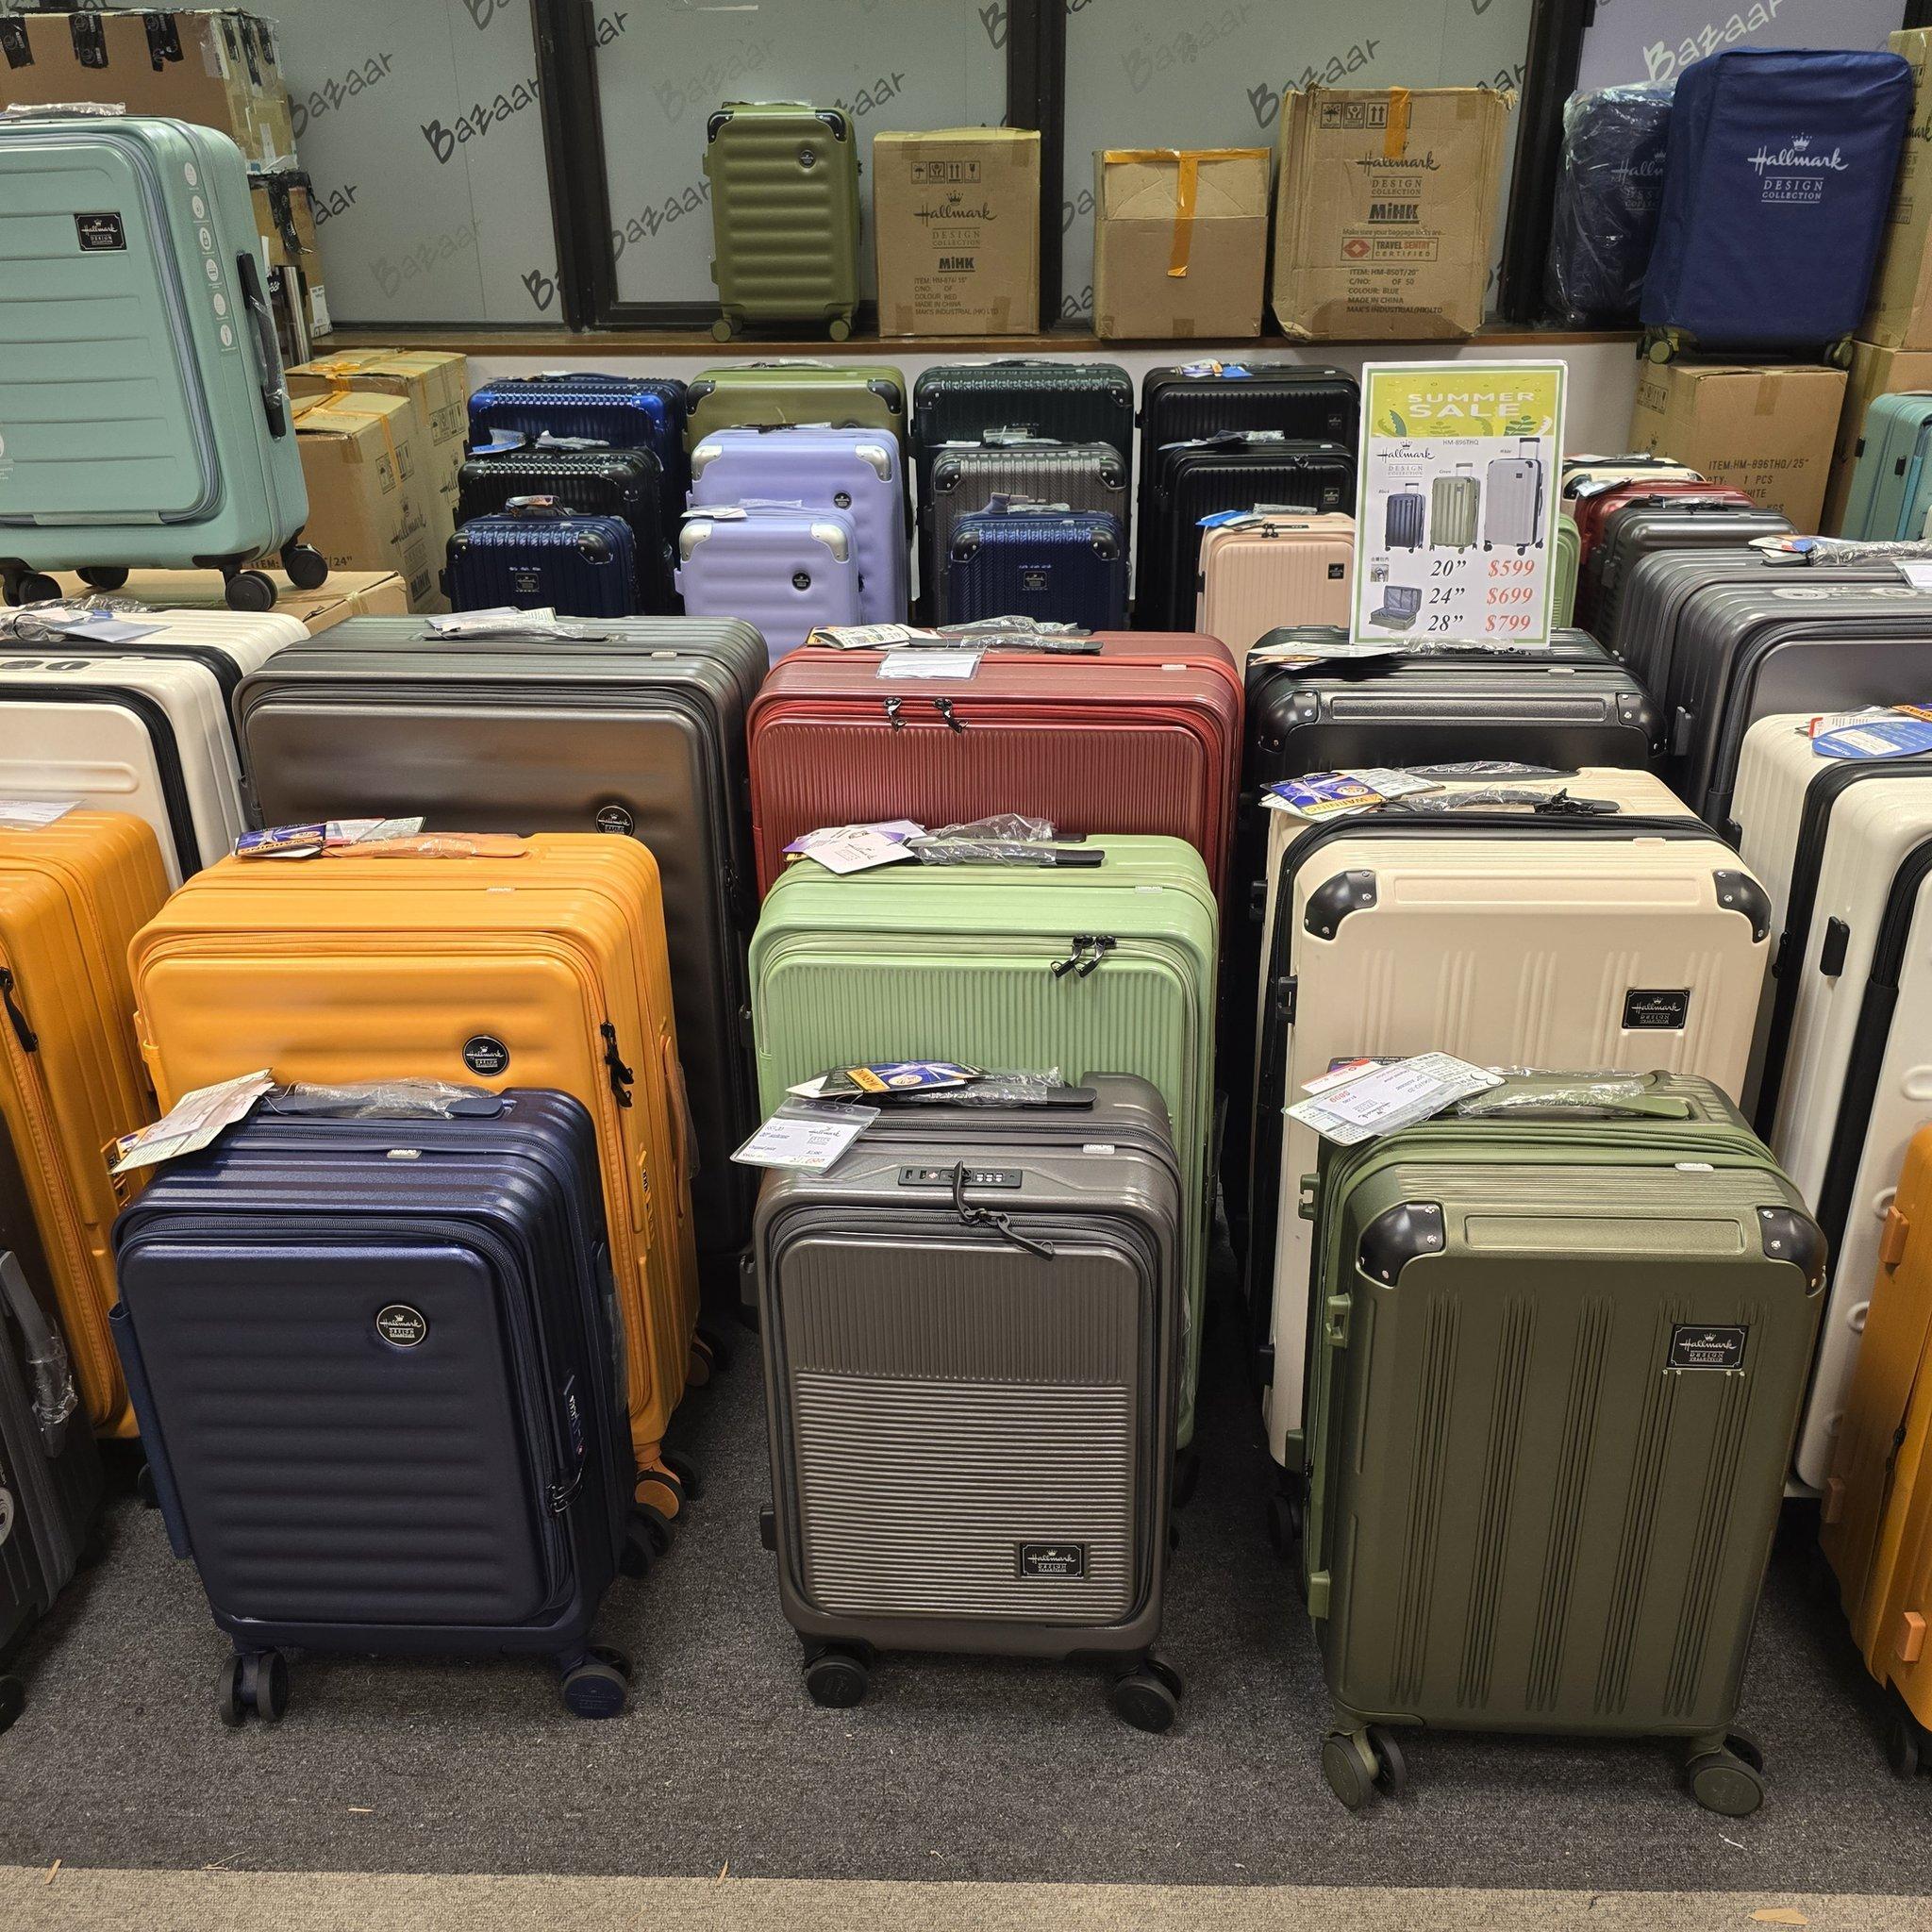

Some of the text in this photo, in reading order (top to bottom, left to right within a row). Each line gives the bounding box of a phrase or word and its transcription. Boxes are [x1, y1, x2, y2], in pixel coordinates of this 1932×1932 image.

[421, 77, 541, 164] Bazaar
[1747, 147, 1849, 176] Hallmark
[1371, 178, 1422, 188] DESIGN
[1763, 180, 1824, 192] DESIGN
[1762, 192, 1822, 200] COLLECTION
[913, 202, 998, 227] Hallmark
[933, 229, 981, 239] DESIGN
[1376, 241, 1403, 250] TRAVEL
[939, 257, 975, 270] MiHK
[1407, 391, 1535, 404] SUMMER
[1408, 403, 1520, 419] SALE
[1376, 446, 1436, 463] Hallmark
[1756, 475, 1774, 485] PCS
[1488, 558, 1536, 577] $599
[1486, 587, 1534, 605] $699
[1485, 614, 1531, 633] $799
[1631, 1002, 1681, 1014] Hallmark
[466, 1049, 505, 1060] Hallmark
[379, 1319, 423, 1329] Hallmark
[1678, 1338, 1737, 1352] Hallmark
[1027, 1553, 1076, 1564] Hallmark
